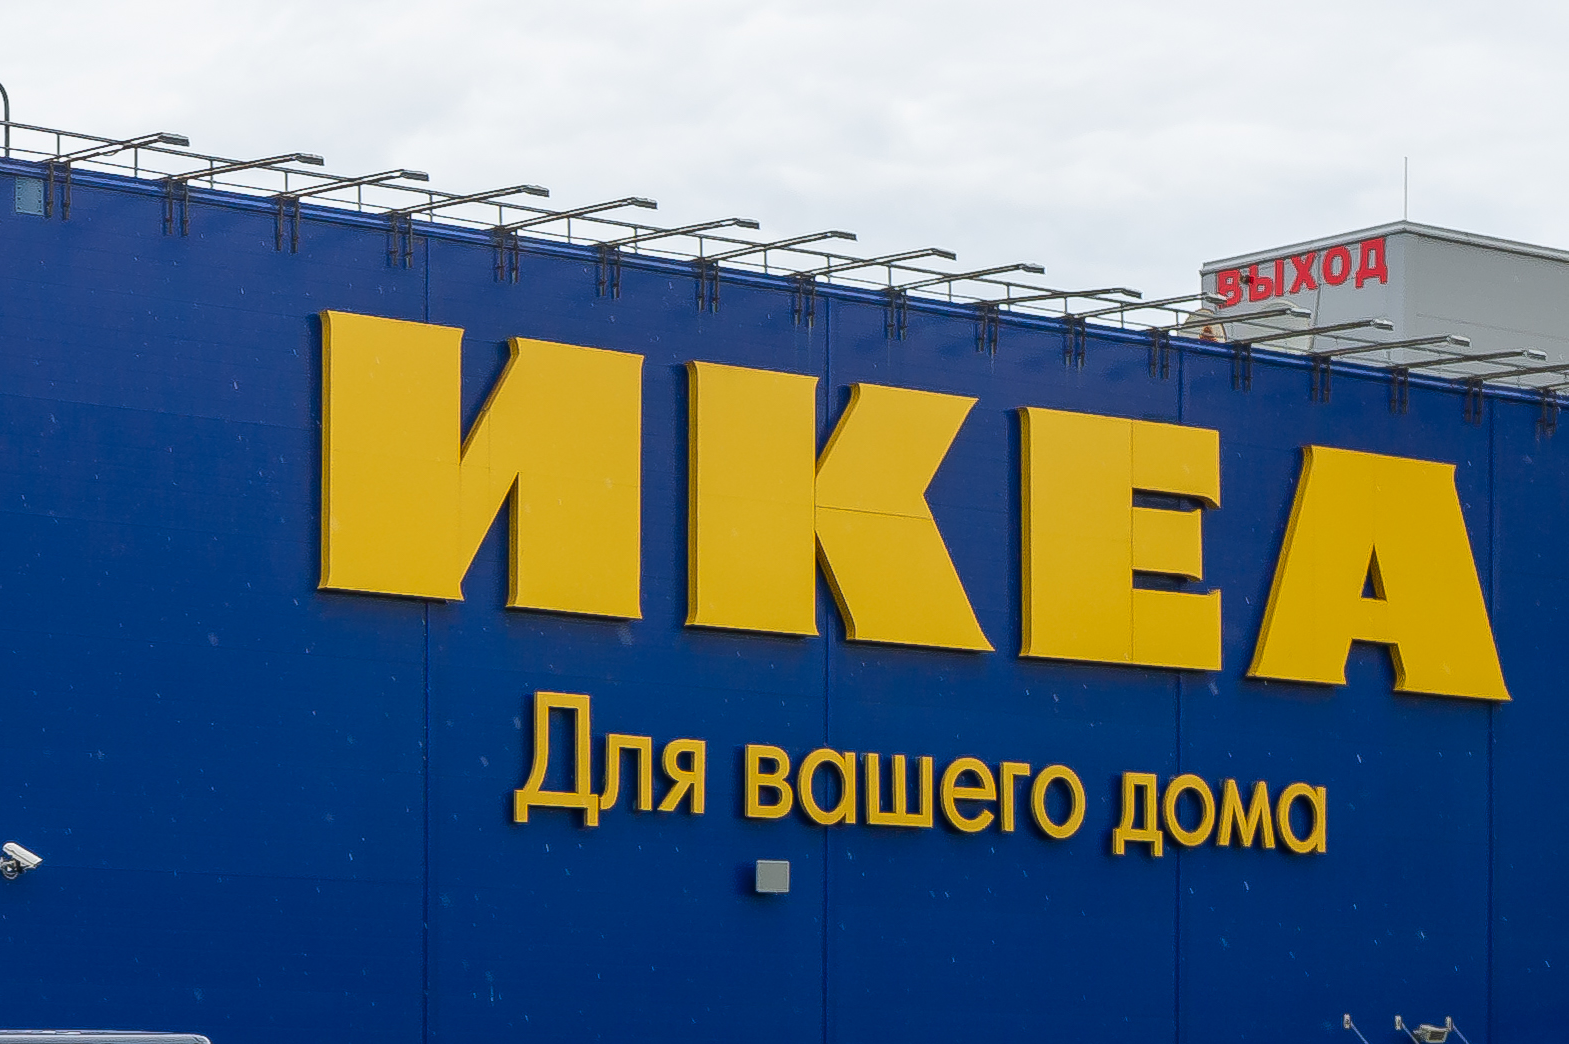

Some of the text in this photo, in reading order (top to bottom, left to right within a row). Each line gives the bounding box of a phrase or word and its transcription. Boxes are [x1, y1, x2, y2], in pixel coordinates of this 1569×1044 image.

[1216, 236, 1388, 308] ВЫХОД
[317, 309, 1511, 701] ИКЕА
[513, 691, 1328, 857] Для вашего дома
